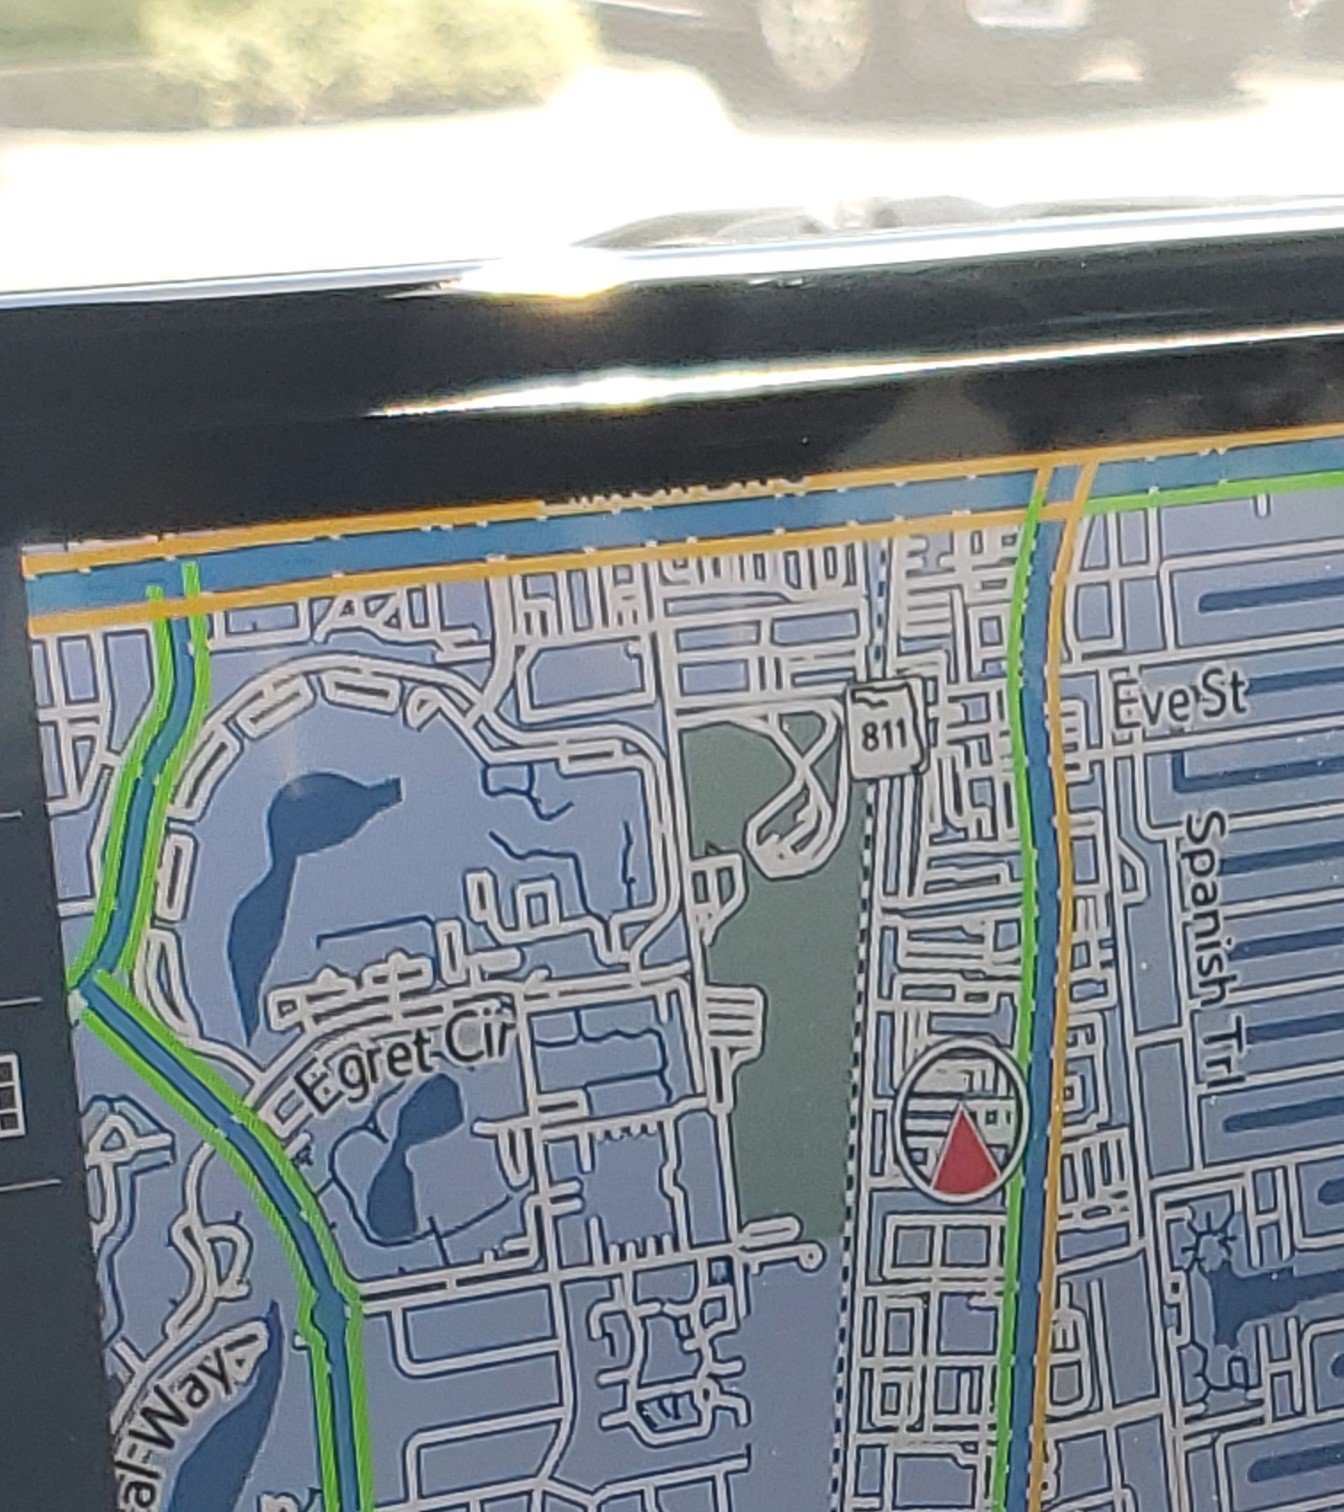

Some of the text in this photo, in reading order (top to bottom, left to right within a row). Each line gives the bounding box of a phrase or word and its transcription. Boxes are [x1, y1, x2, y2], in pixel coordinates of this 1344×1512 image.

[860, 716, 908, 753] 811
[1113, 666, 1248, 729] Eve St
[1179, 810, 1237, 1008] Spanish
[294, 1008, 512, 1114] Egret Cir
[129, 1345, 236, 1450] Way
